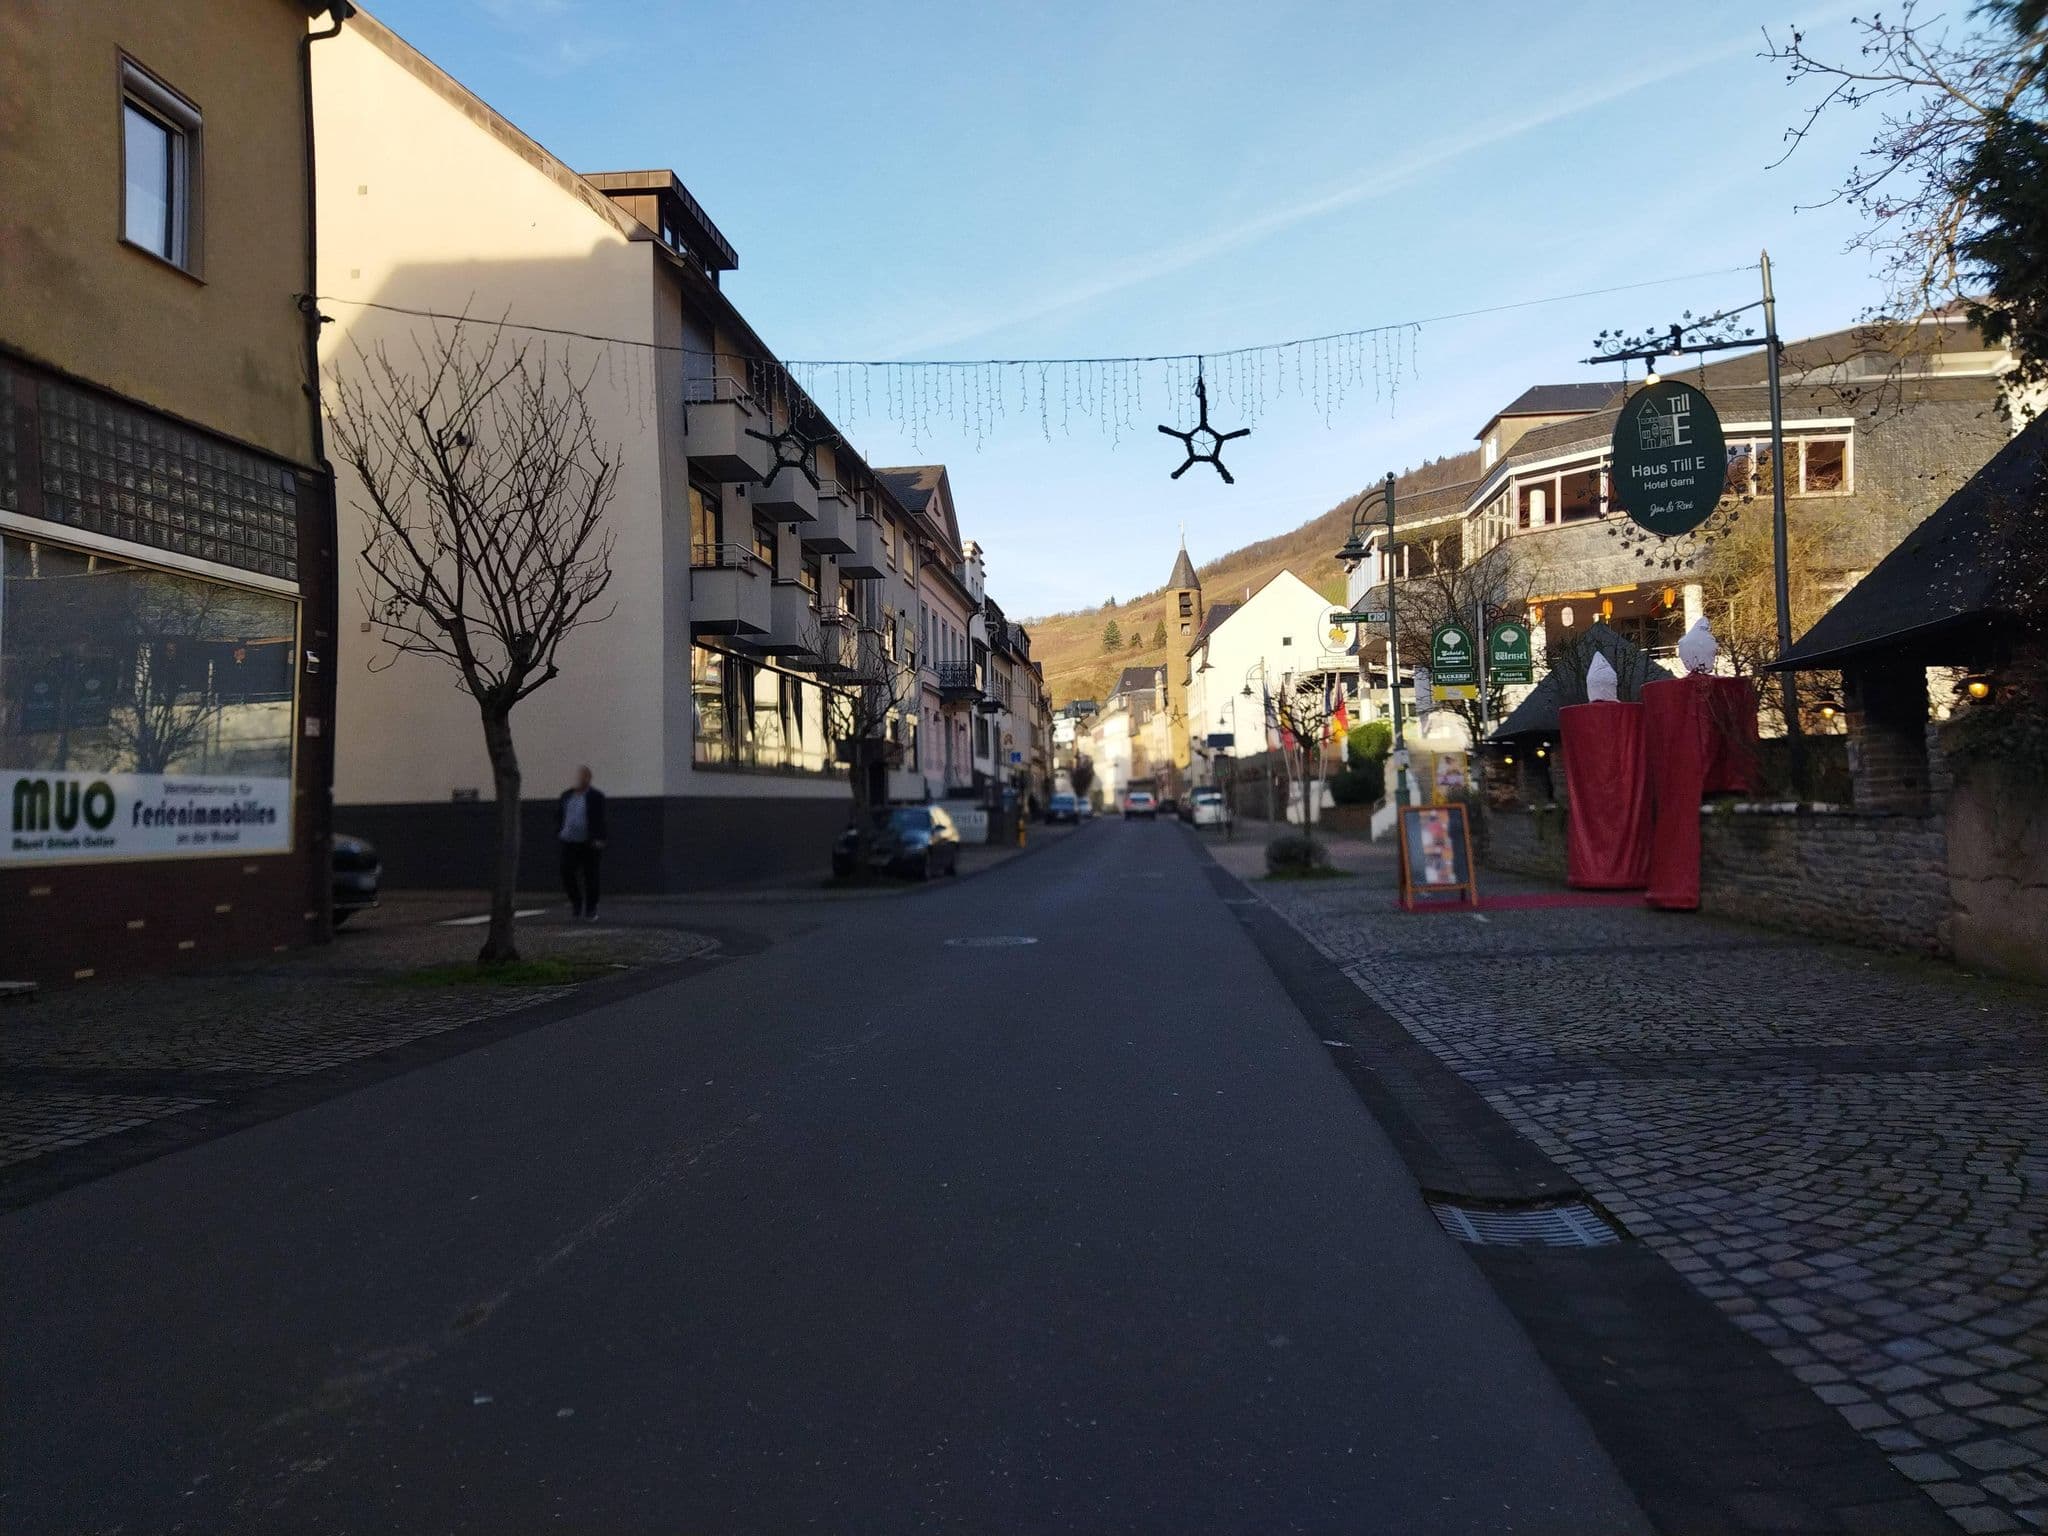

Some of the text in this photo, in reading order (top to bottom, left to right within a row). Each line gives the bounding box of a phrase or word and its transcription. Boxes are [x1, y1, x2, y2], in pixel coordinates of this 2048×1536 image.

[1667, 393, 1690, 413] Till
[1672, 412, 1692, 445] E
[1631, 456, 1706, 478] Haus Till E
[1644, 476, 1695, 491] Hotel Garni
[1495, 651, 1528, 661] Wenzel
[12, 777, 116, 832] MUO
